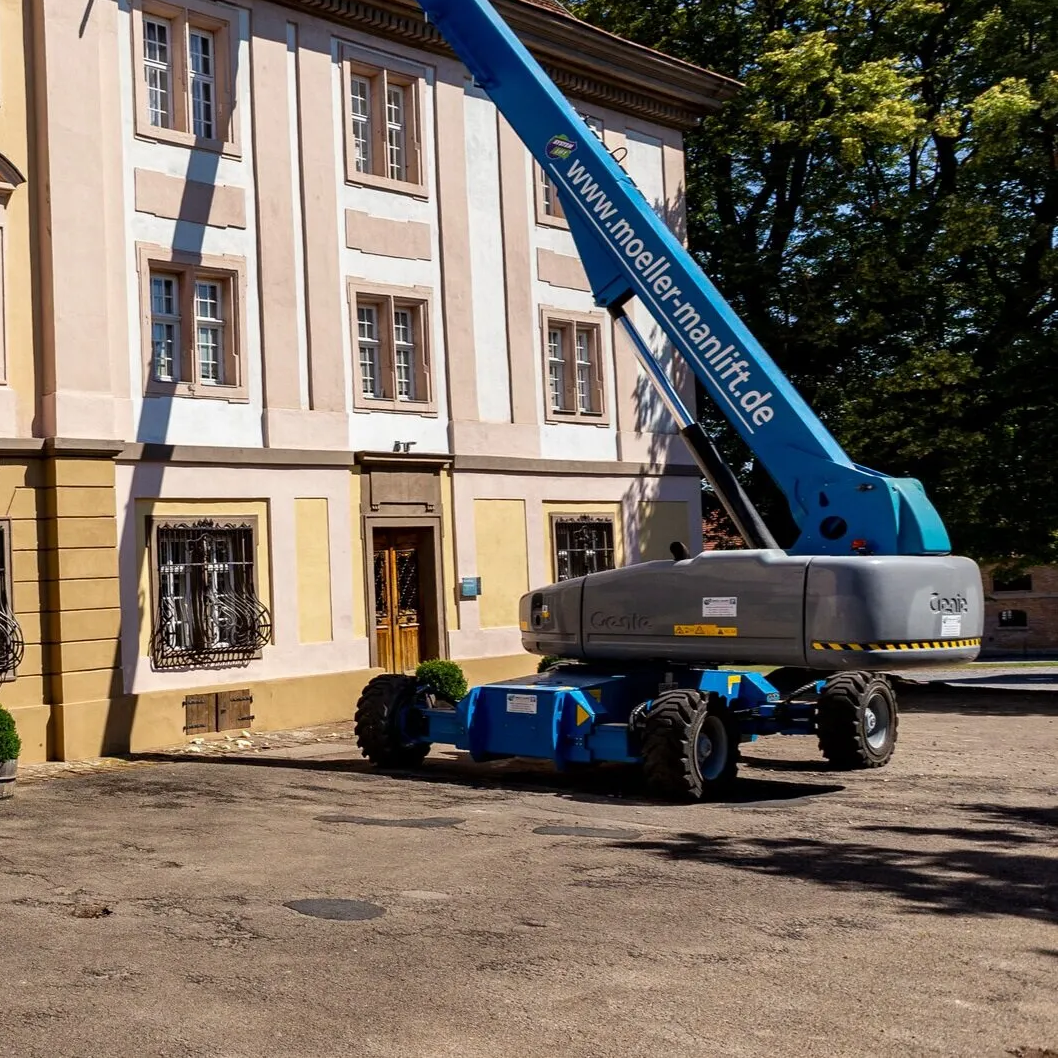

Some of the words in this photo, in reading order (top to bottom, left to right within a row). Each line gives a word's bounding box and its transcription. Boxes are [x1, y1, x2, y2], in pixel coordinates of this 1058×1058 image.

[566, 159, 774, 426] www.moeller-manlift.de
[930, 592, 968, 613] Genie
[590, 611, 653, 630] Genie
